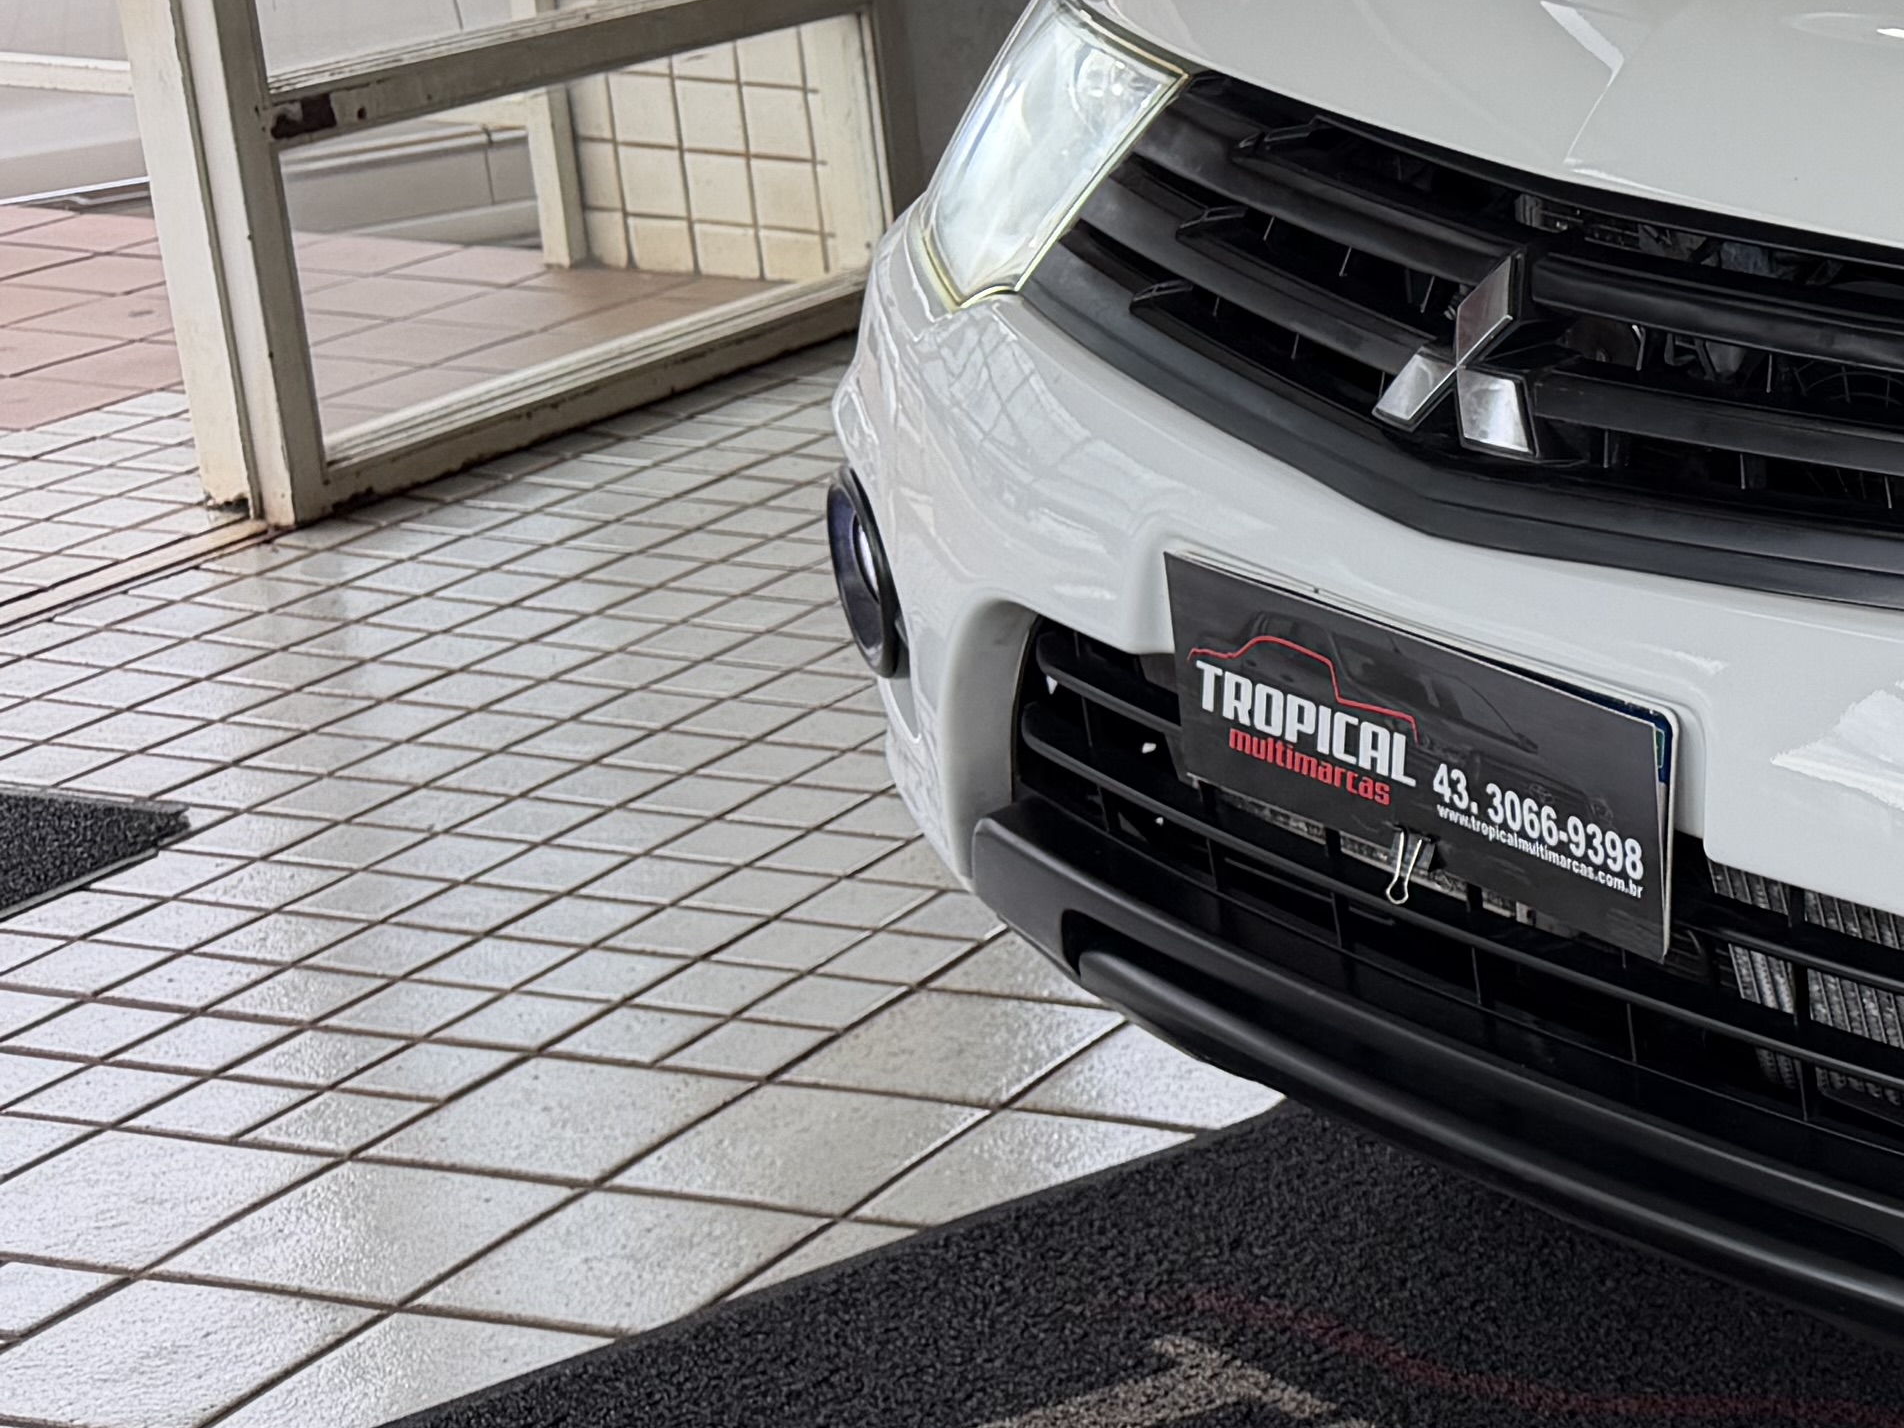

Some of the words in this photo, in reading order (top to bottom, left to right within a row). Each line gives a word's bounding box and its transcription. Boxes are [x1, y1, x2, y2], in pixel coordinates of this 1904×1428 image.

[1196, 659, 1417, 788] TROPICAL
[1229, 727, 1391, 806] multimarcas
[1432, 763, 1479, 815] 43.
[1485, 782, 1645, 881] 3066-9398
[1437, 803, 1644, 899] www.tropicalmultimarcas.com.br
